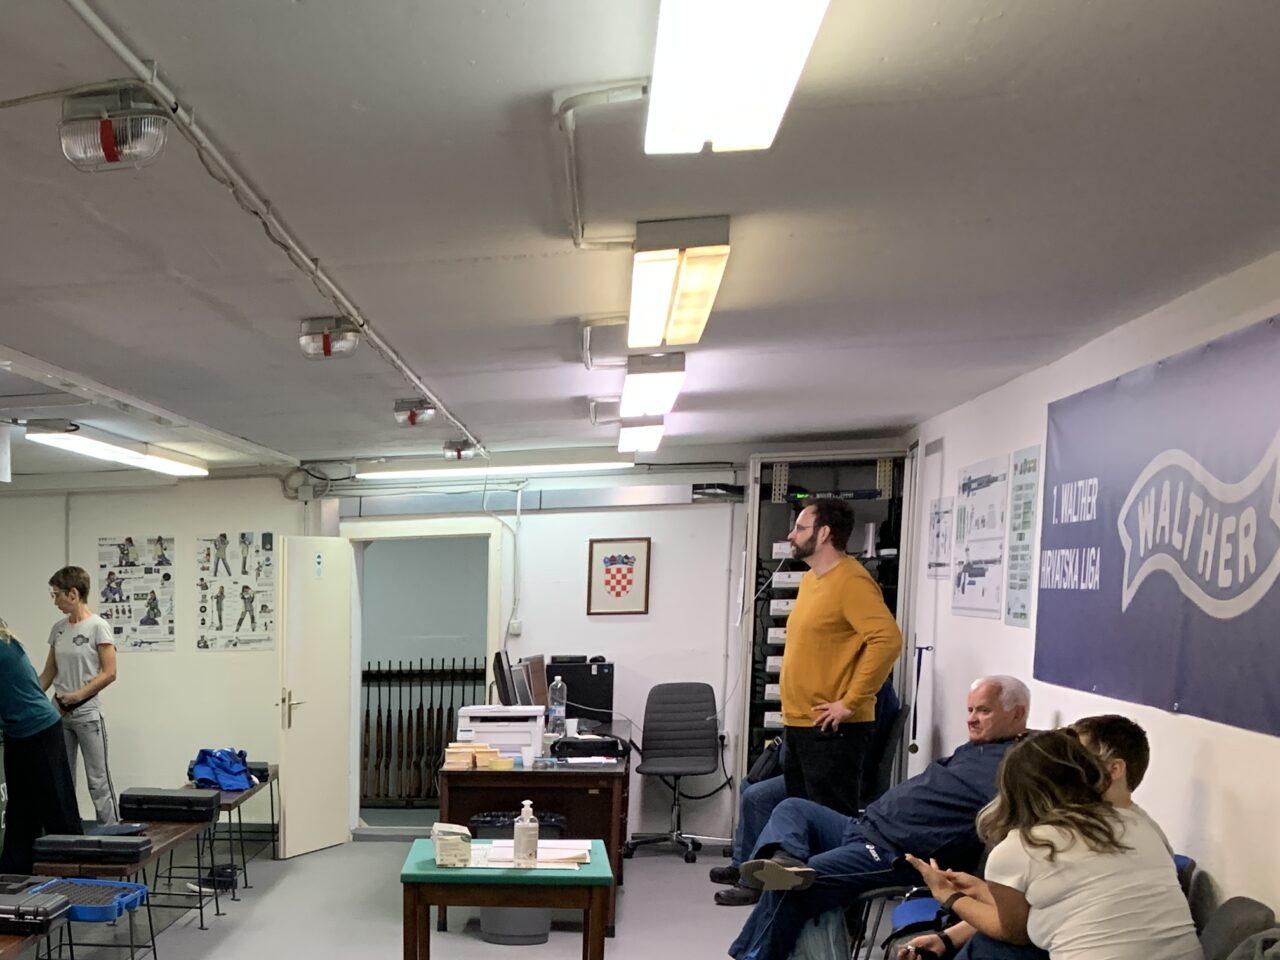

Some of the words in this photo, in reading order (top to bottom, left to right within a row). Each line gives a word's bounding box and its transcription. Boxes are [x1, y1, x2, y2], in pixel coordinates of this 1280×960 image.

[1061, 477, 1098, 524] WALTHER
[1137, 480, 1257, 588] WALTHER
[1040, 548, 1079, 590] HRVATSKA
[1080, 546, 1101, 591] LIGA
